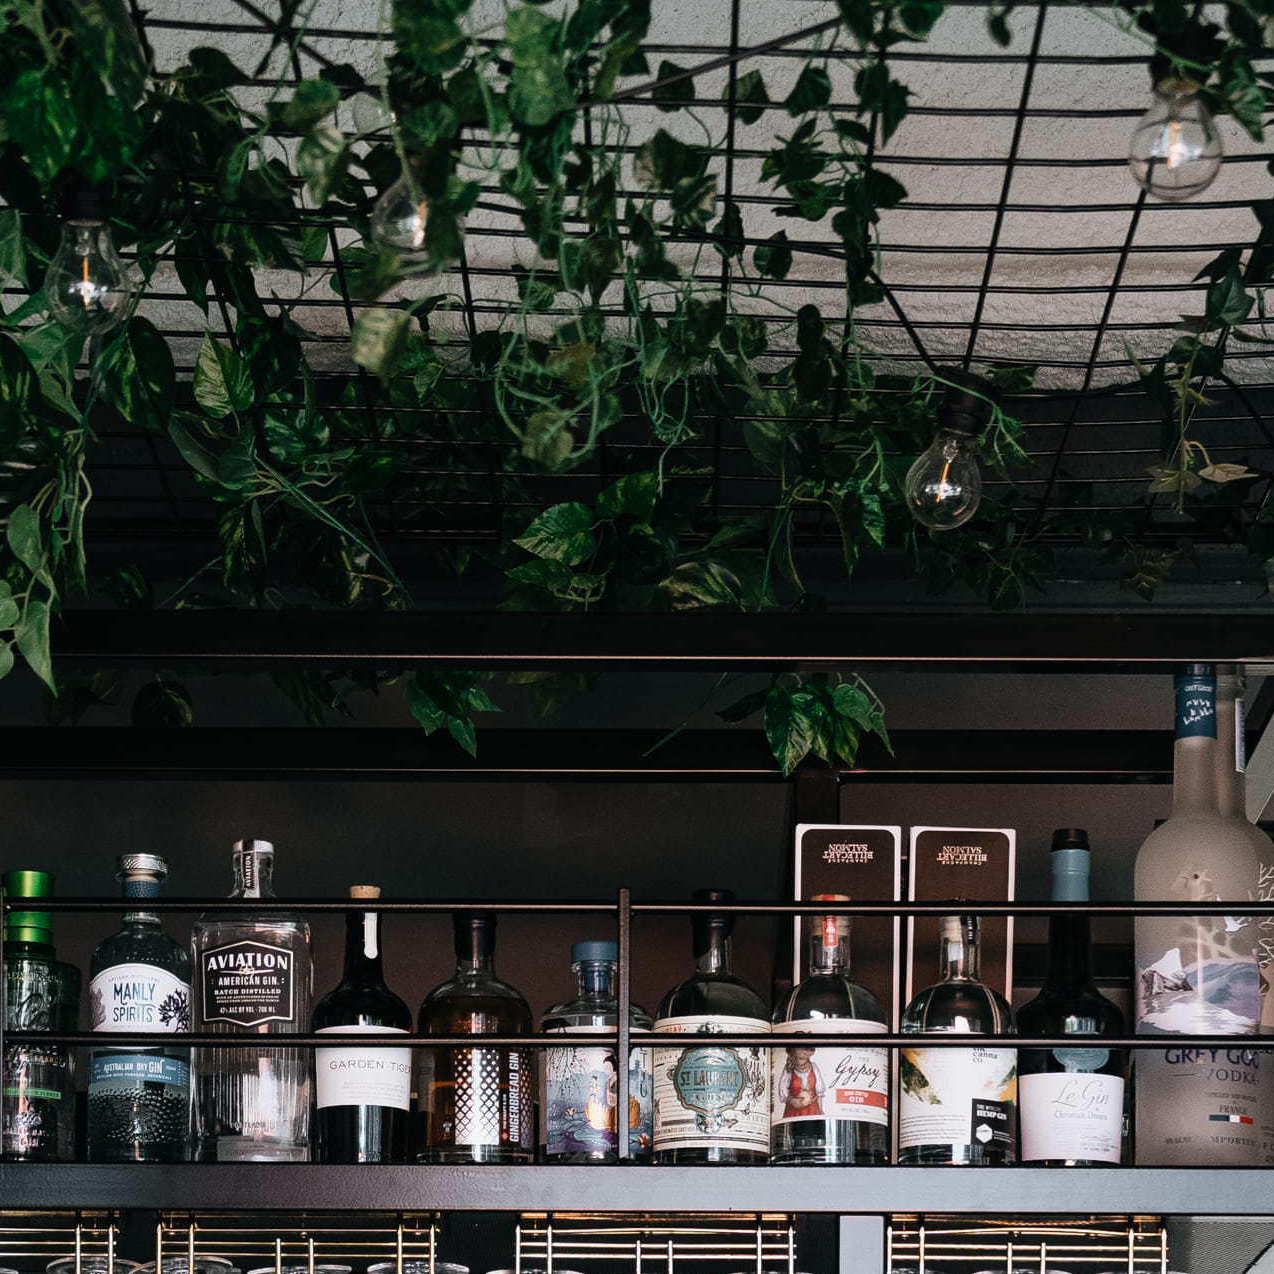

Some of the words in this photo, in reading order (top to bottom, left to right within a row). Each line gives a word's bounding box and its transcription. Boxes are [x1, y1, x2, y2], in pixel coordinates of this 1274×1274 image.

[828, 843, 869, 851] SALMON
[943, 845, 983, 854] SALMON
[823, 850, 874, 860] BILLECART
[936, 852, 988, 862] BILLECART
[207, 953, 288, 971] AVIATION
[218, 976, 260, 986] AMERICAN
[113, 983, 156, 1006] MANLY
[113, 1002, 156, 1023] SPIRITS
[509, 1052, 519, 1070] GIN
[1165, 1049, 1220, 1065] GREY
[104, 1062, 134, 1073] AUSTRALIAN
[137, 1062, 147, 1071] DRY
[149, 1060, 165, 1074] GIN
[329, 1060, 384, 1070] GARDEN
[829, 1055, 880, 1088] Gypsy
[693, 1071, 739, 1086] LAURENT
[1050, 1080, 1078, 1108] Le
[1082, 1080, 1109, 1110] Gin
[509, 1073, 519, 1143] GINGERBREAD
[1219, 1105, 1247, 1114] FRANCE
